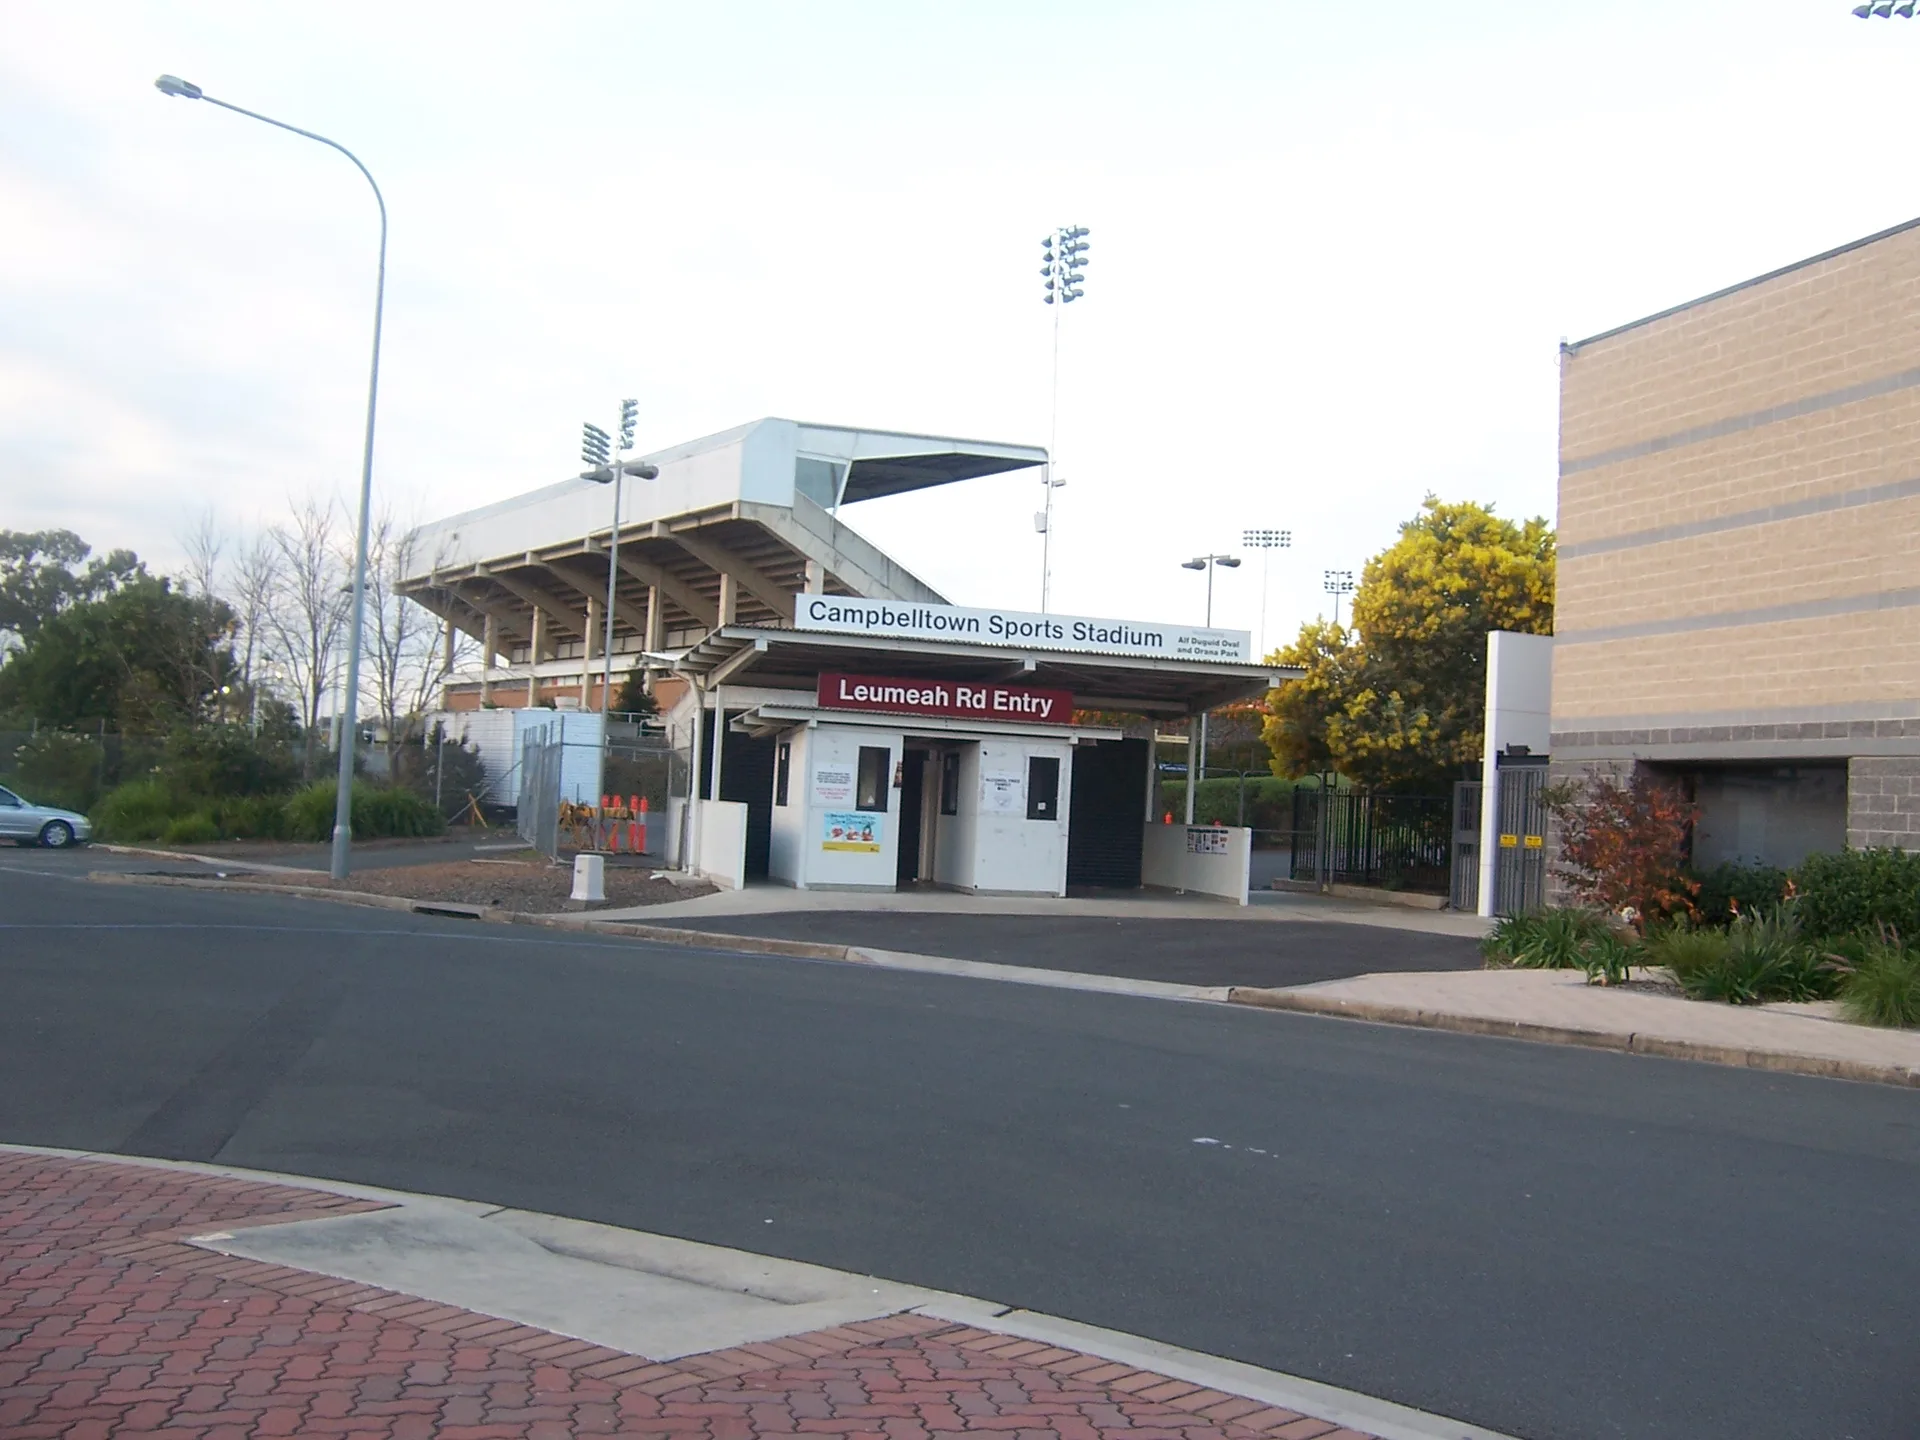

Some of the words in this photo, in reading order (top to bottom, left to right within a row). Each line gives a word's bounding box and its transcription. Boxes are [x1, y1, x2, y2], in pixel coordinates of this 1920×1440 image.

[809, 601, 980, 633] Campbelltown
[988, 615, 1064, 640] Sports
[1072, 621, 1163, 648] Stadium
[1177, 646, 1192, 654] and
[1194, 647, 1219, 656] Orana
[1220, 649, 1239, 657] Park
[1178, 636, 1190, 644] Alf
[1191, 637, 1220, 648] Duguid
[1221, 639, 1240, 648] Oval
[839, 678, 949, 707] Leumeah
[956, 687, 987, 709] Rd
[993, 690, 1053, 718] Entry
